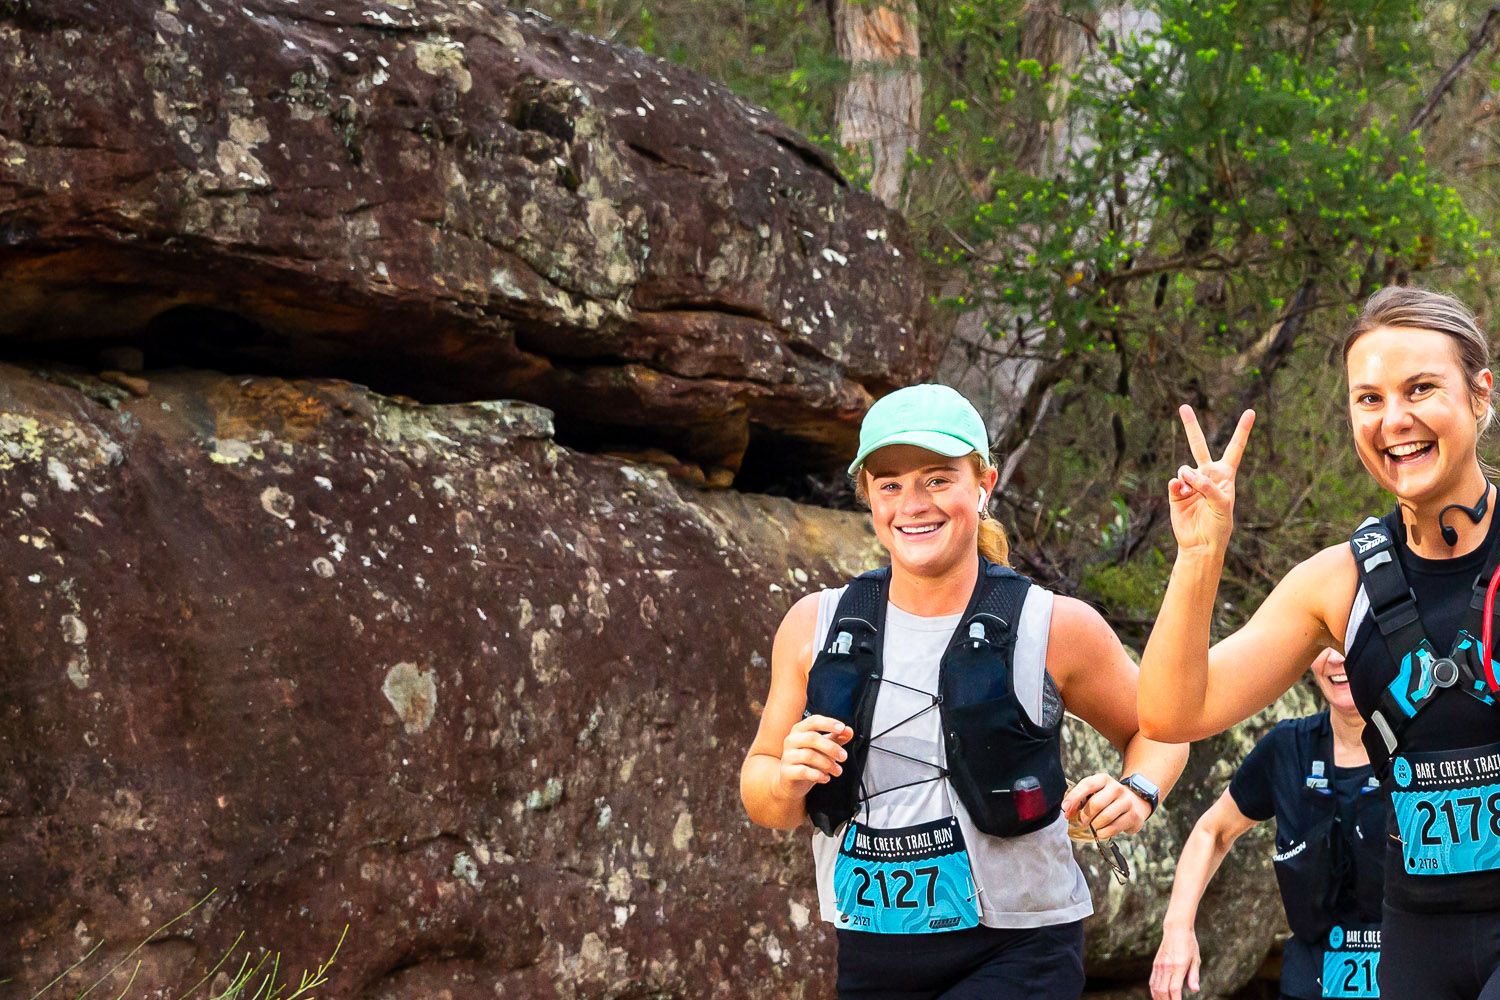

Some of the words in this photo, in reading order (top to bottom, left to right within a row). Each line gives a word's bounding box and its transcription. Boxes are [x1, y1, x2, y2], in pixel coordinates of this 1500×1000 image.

[1415, 762, 1437, 779] BARE
[1440, 759, 1472, 777] CREEK
[873, 836, 903, 851] CREEK
[905, 832, 933, 850] TRAIL
[933, 827, 953, 845] RUN
[1418, 858, 1439, 870] 2178
[852, 865, 939, 909] 2127
[853, 914, 871, 927] 2127
[1363, 930, 1382, 943] CREE
[1343, 958, 1372, 992] 21
